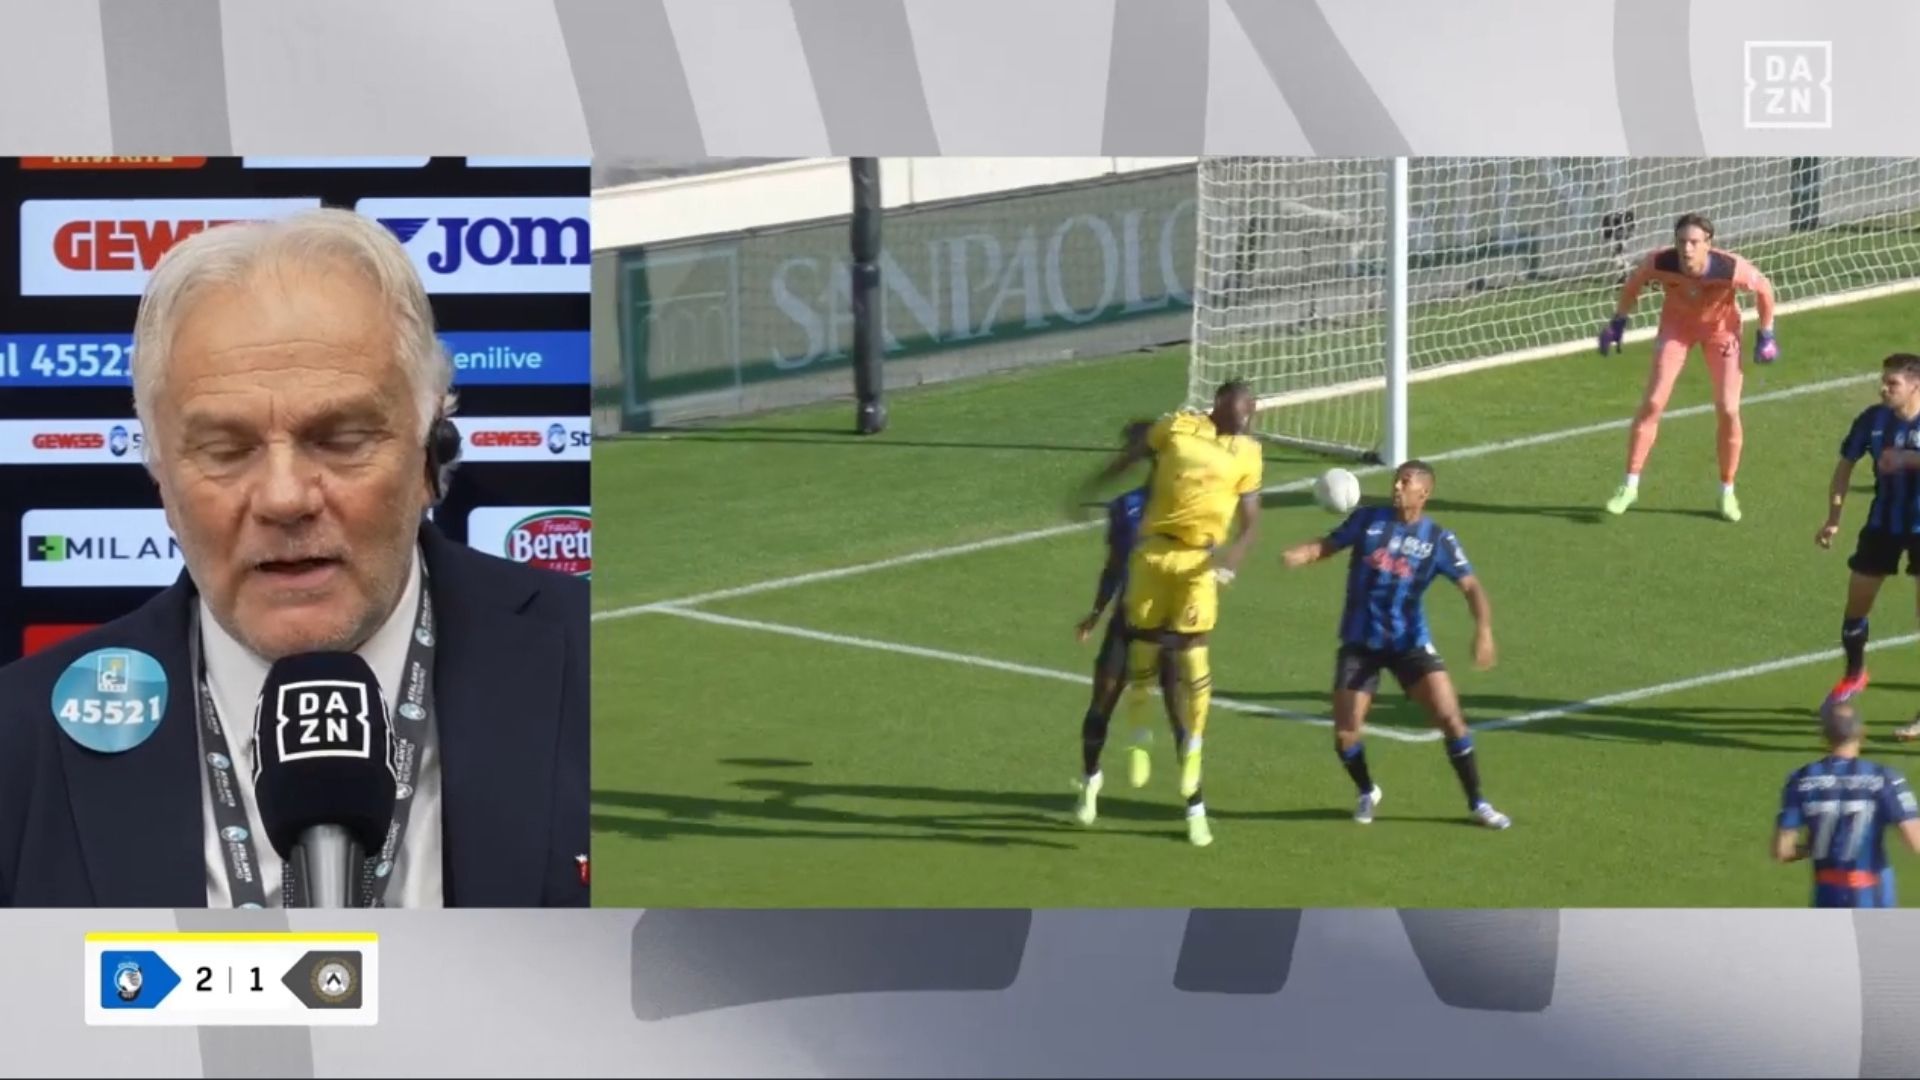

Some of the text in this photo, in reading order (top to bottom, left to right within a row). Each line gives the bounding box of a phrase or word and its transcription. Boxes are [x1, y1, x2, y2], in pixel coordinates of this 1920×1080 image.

[454, 346, 544, 369] enilive
[32, 433, 104, 449] GEWISS
[470, 431, 543, 447] GEWISS
[60, 695, 160, 725] 45521
[299, 691, 349, 716] DA
[299, 717, 348, 744] ZN
[1802, 800, 1876, 862] 77
